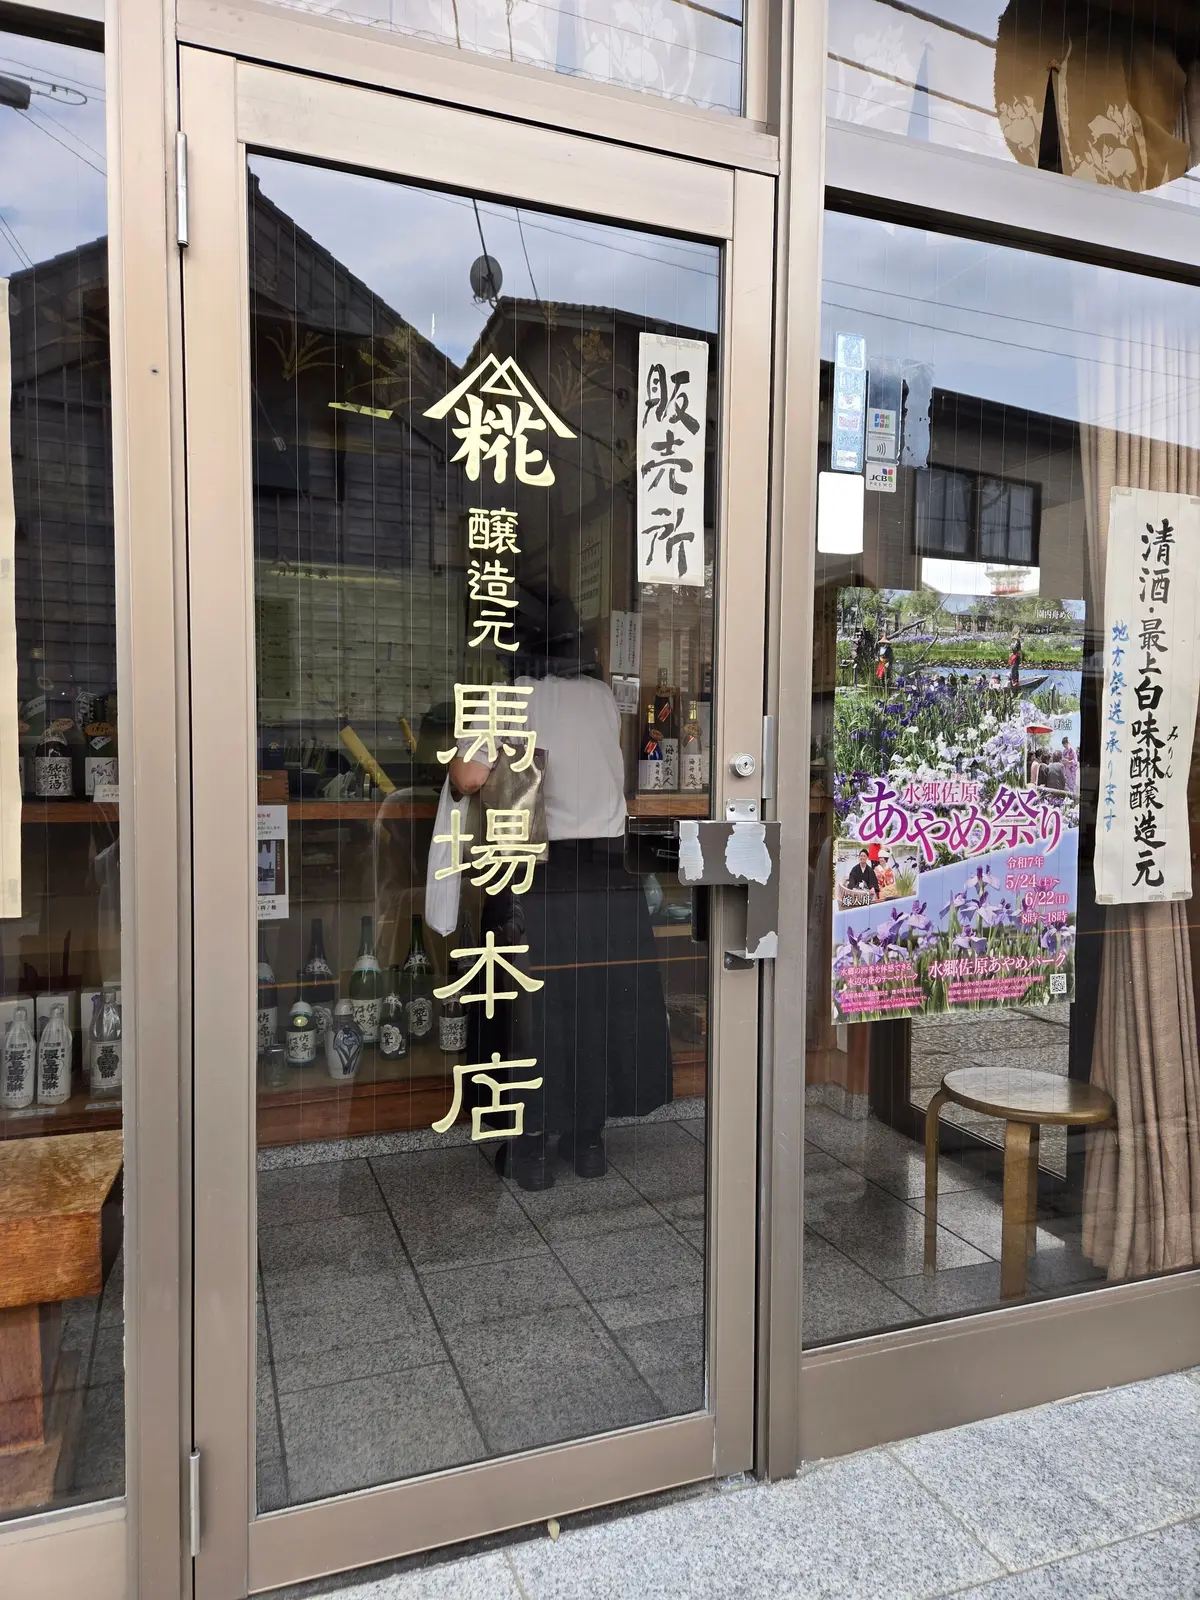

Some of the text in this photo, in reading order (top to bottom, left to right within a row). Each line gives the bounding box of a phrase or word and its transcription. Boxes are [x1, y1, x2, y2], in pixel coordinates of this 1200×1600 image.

[450, 393, 556, 487] 糀
[641, 362, 701, 577] 販売所
[869, 474, 888, 482] JCB
[467, 507, 521, 652] 醸造元
[1164, 725, 1179, 779] みりん
[859, 781, 1062, 863] あやめ祭り
[902, 781, 979, 804] 水郷佐原
[1007, 856, 1045, 869] 令和7年
[431, 682, 547, 1142] 馬場本店
[928, 951, 1067, 979] 水郷佐原あやめパーク
